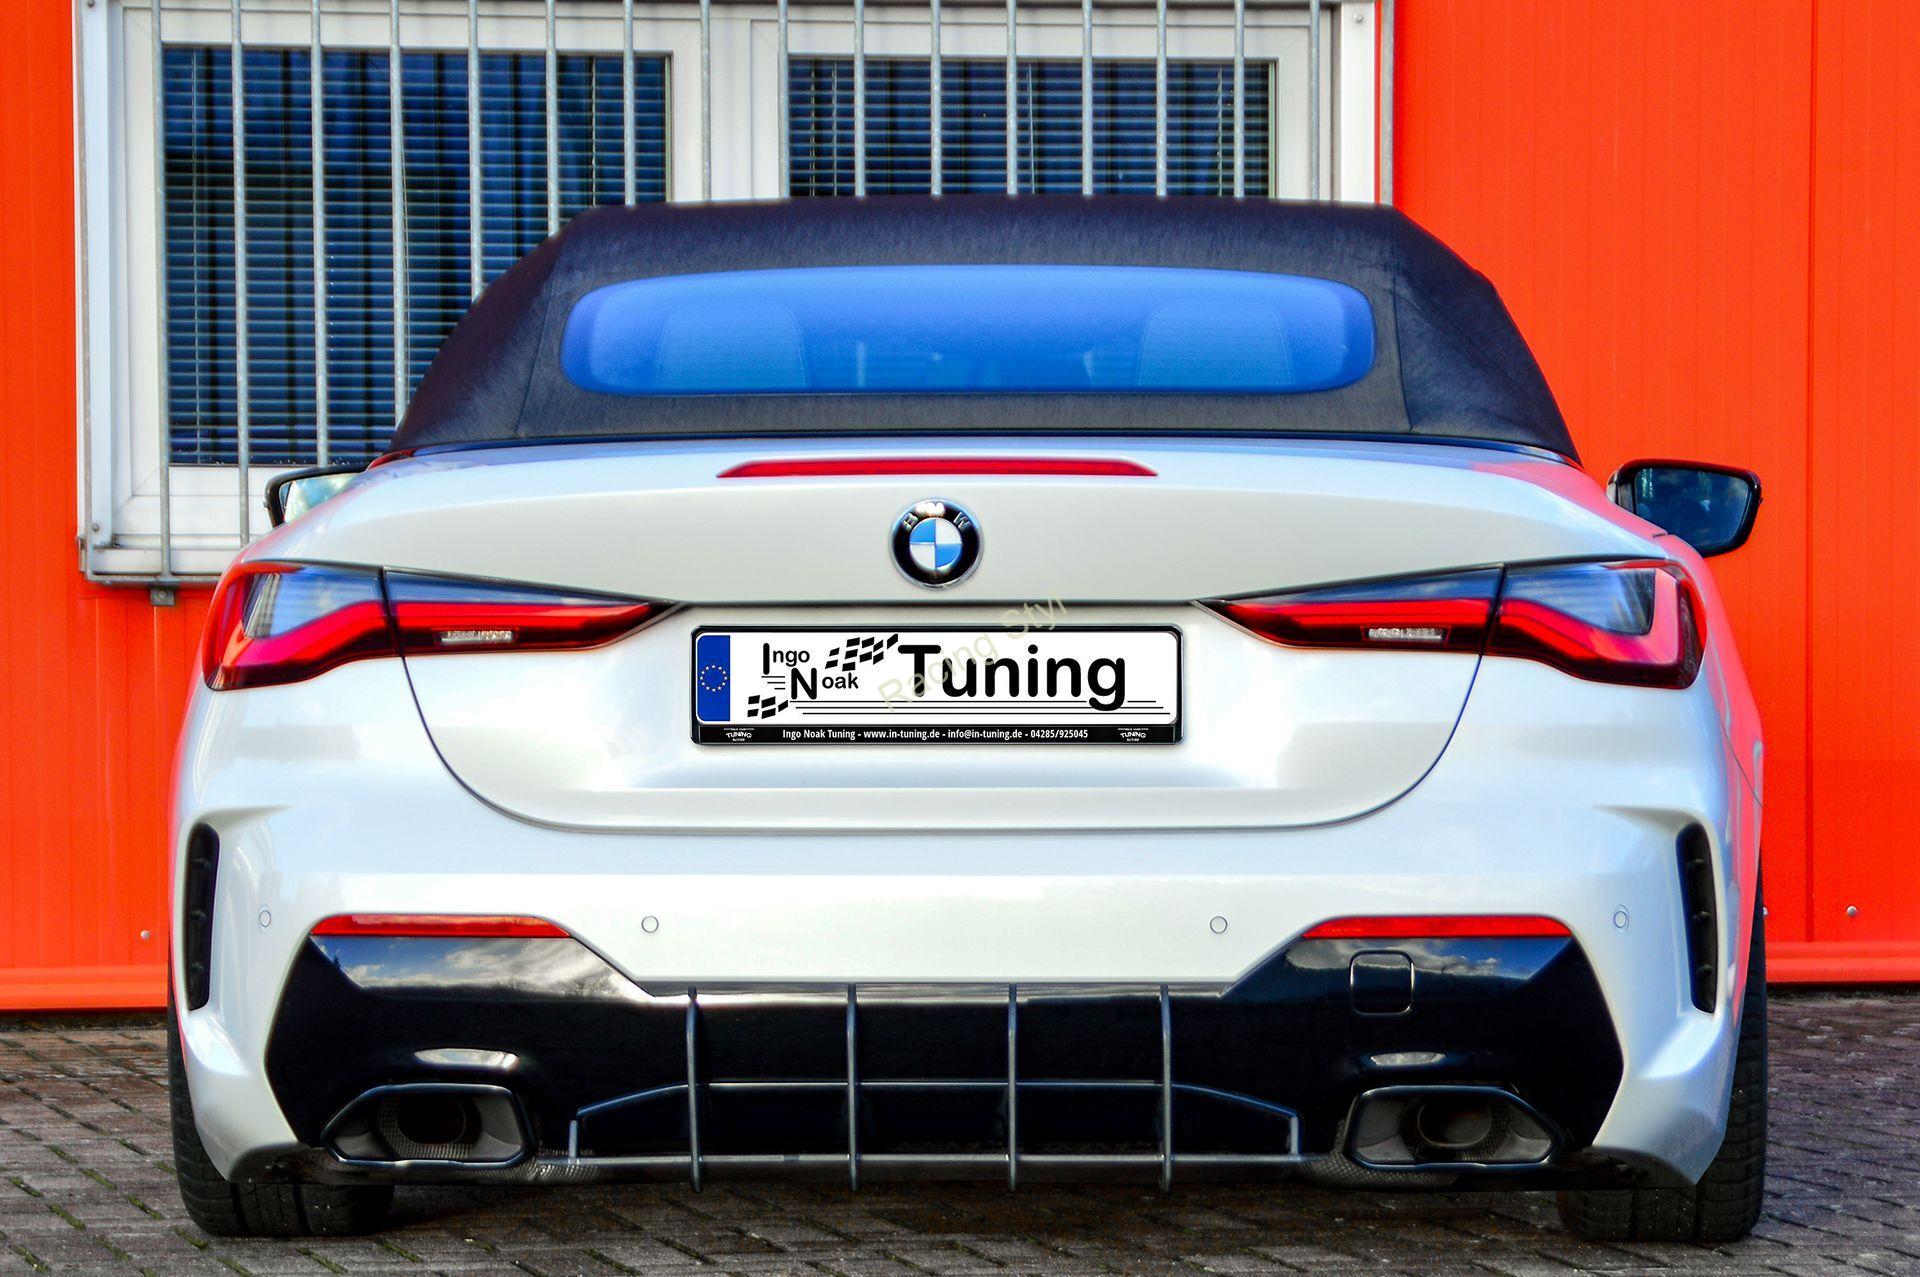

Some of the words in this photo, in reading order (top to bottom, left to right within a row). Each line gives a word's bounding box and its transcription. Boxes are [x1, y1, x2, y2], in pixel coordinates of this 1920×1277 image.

[763, 643, 811, 676] Ingo
[791, 668, 859, 700] Noak
[898, 644, 1126, 711] Tuning
[782, 730, 801, 740] Ingo
[803, 729, 826, 739] Noak
[828, 730, 856, 740] Tuning
[863, 729, 940, 740] www.in-tuning.de
[948, 729, 1023, 740] info@in-tuning.de
[1031, 730, 1089, 739] 04285/925045
